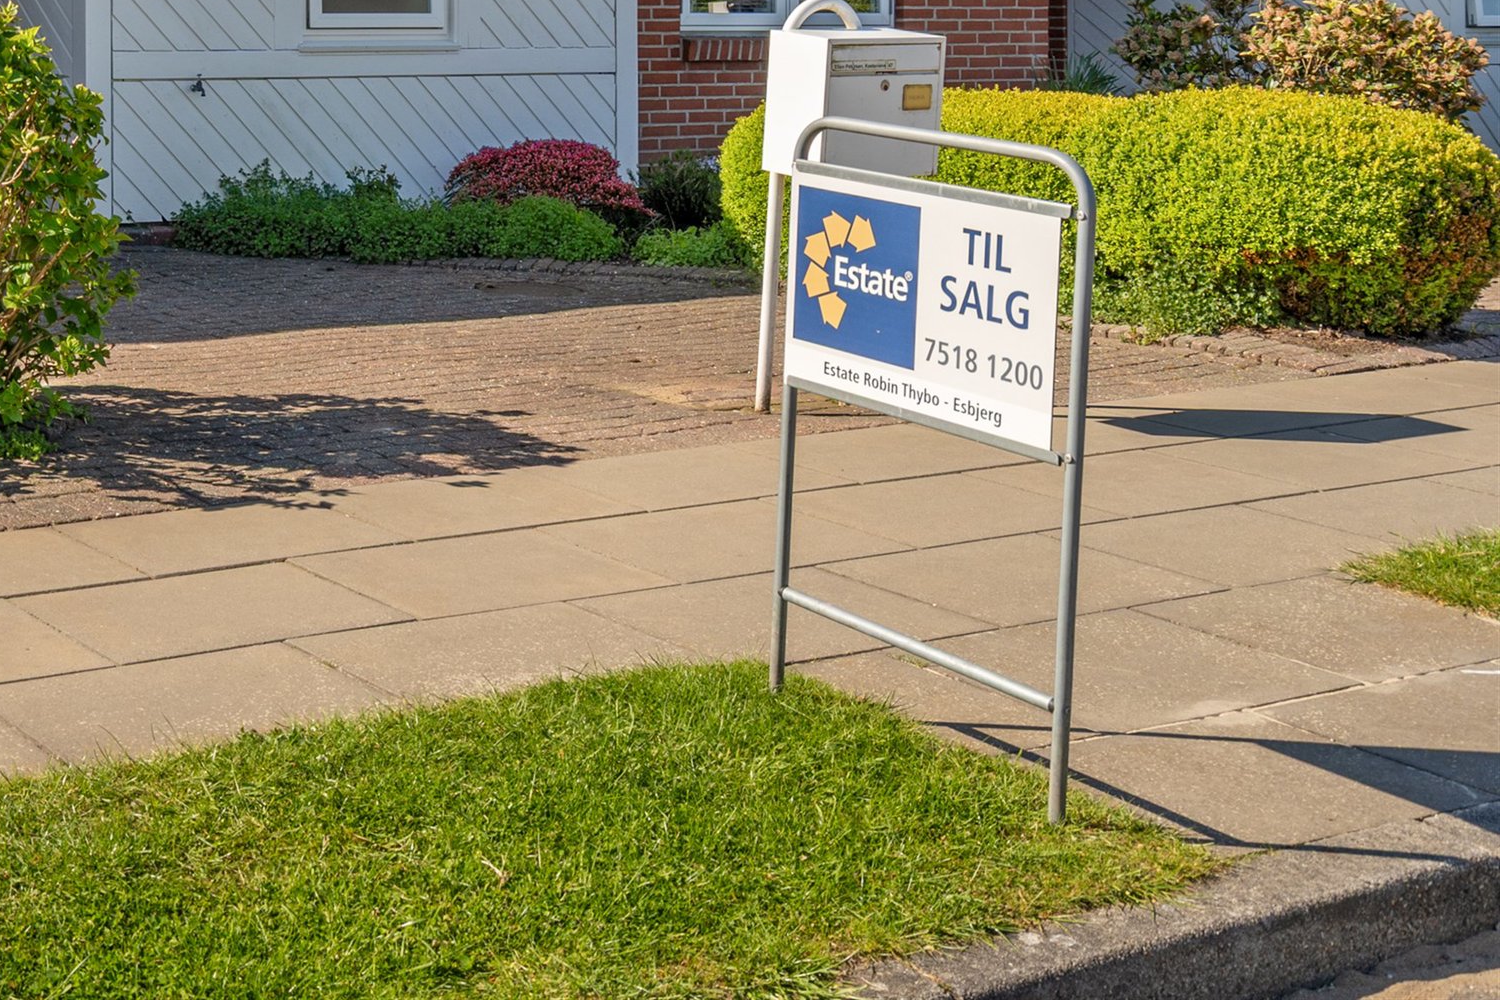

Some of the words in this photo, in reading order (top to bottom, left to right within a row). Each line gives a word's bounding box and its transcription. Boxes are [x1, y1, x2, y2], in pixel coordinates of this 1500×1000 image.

[963, 227, 1012, 274] TIL
[834, 254, 909, 302] Estate
[940, 275, 1030, 330] SALG
[925, 337, 978, 373] 7518
[987, 354, 1043, 390] 1200
[823, 361, 860, 384] Estate
[863, 372, 898, 395] Robin
[901, 382, 940, 406] Thybo
[953, 397, 1002, 428] Esbjerg
